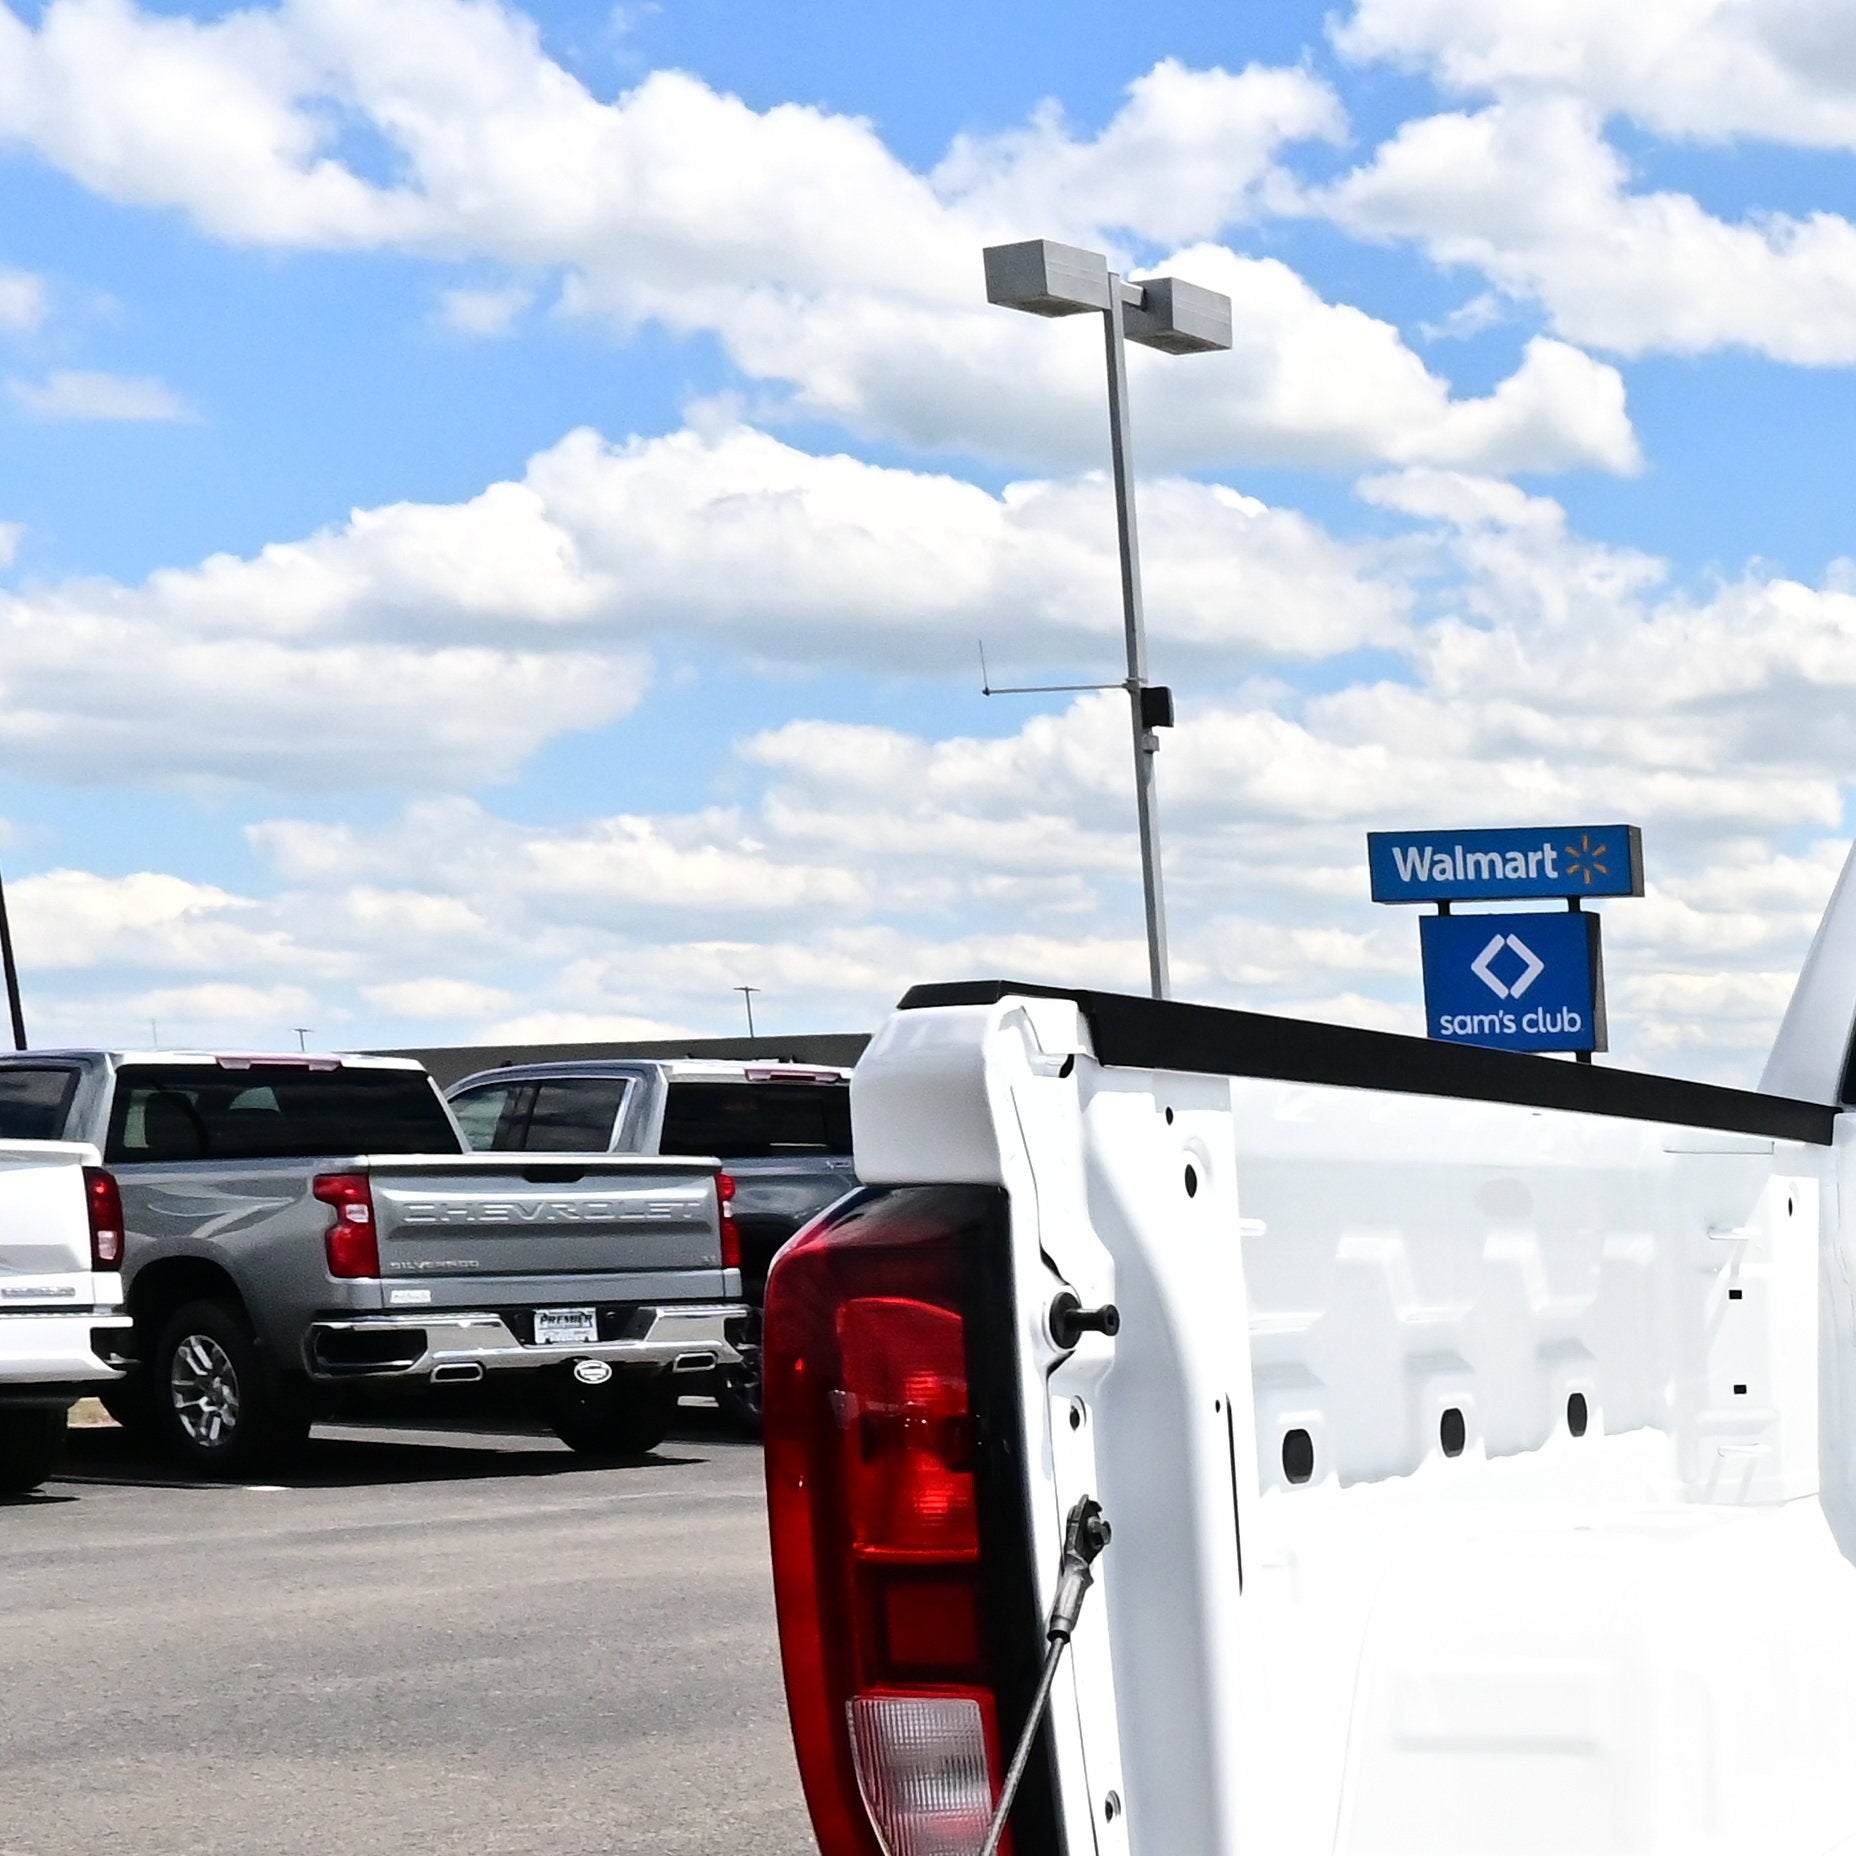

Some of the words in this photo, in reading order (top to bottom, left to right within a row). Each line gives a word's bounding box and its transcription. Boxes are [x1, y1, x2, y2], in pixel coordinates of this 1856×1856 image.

[1392, 843, 1558, 882] Walmart
[1440, 1010, 1516, 1035] sam's
[1522, 1006, 1582, 1033] club
